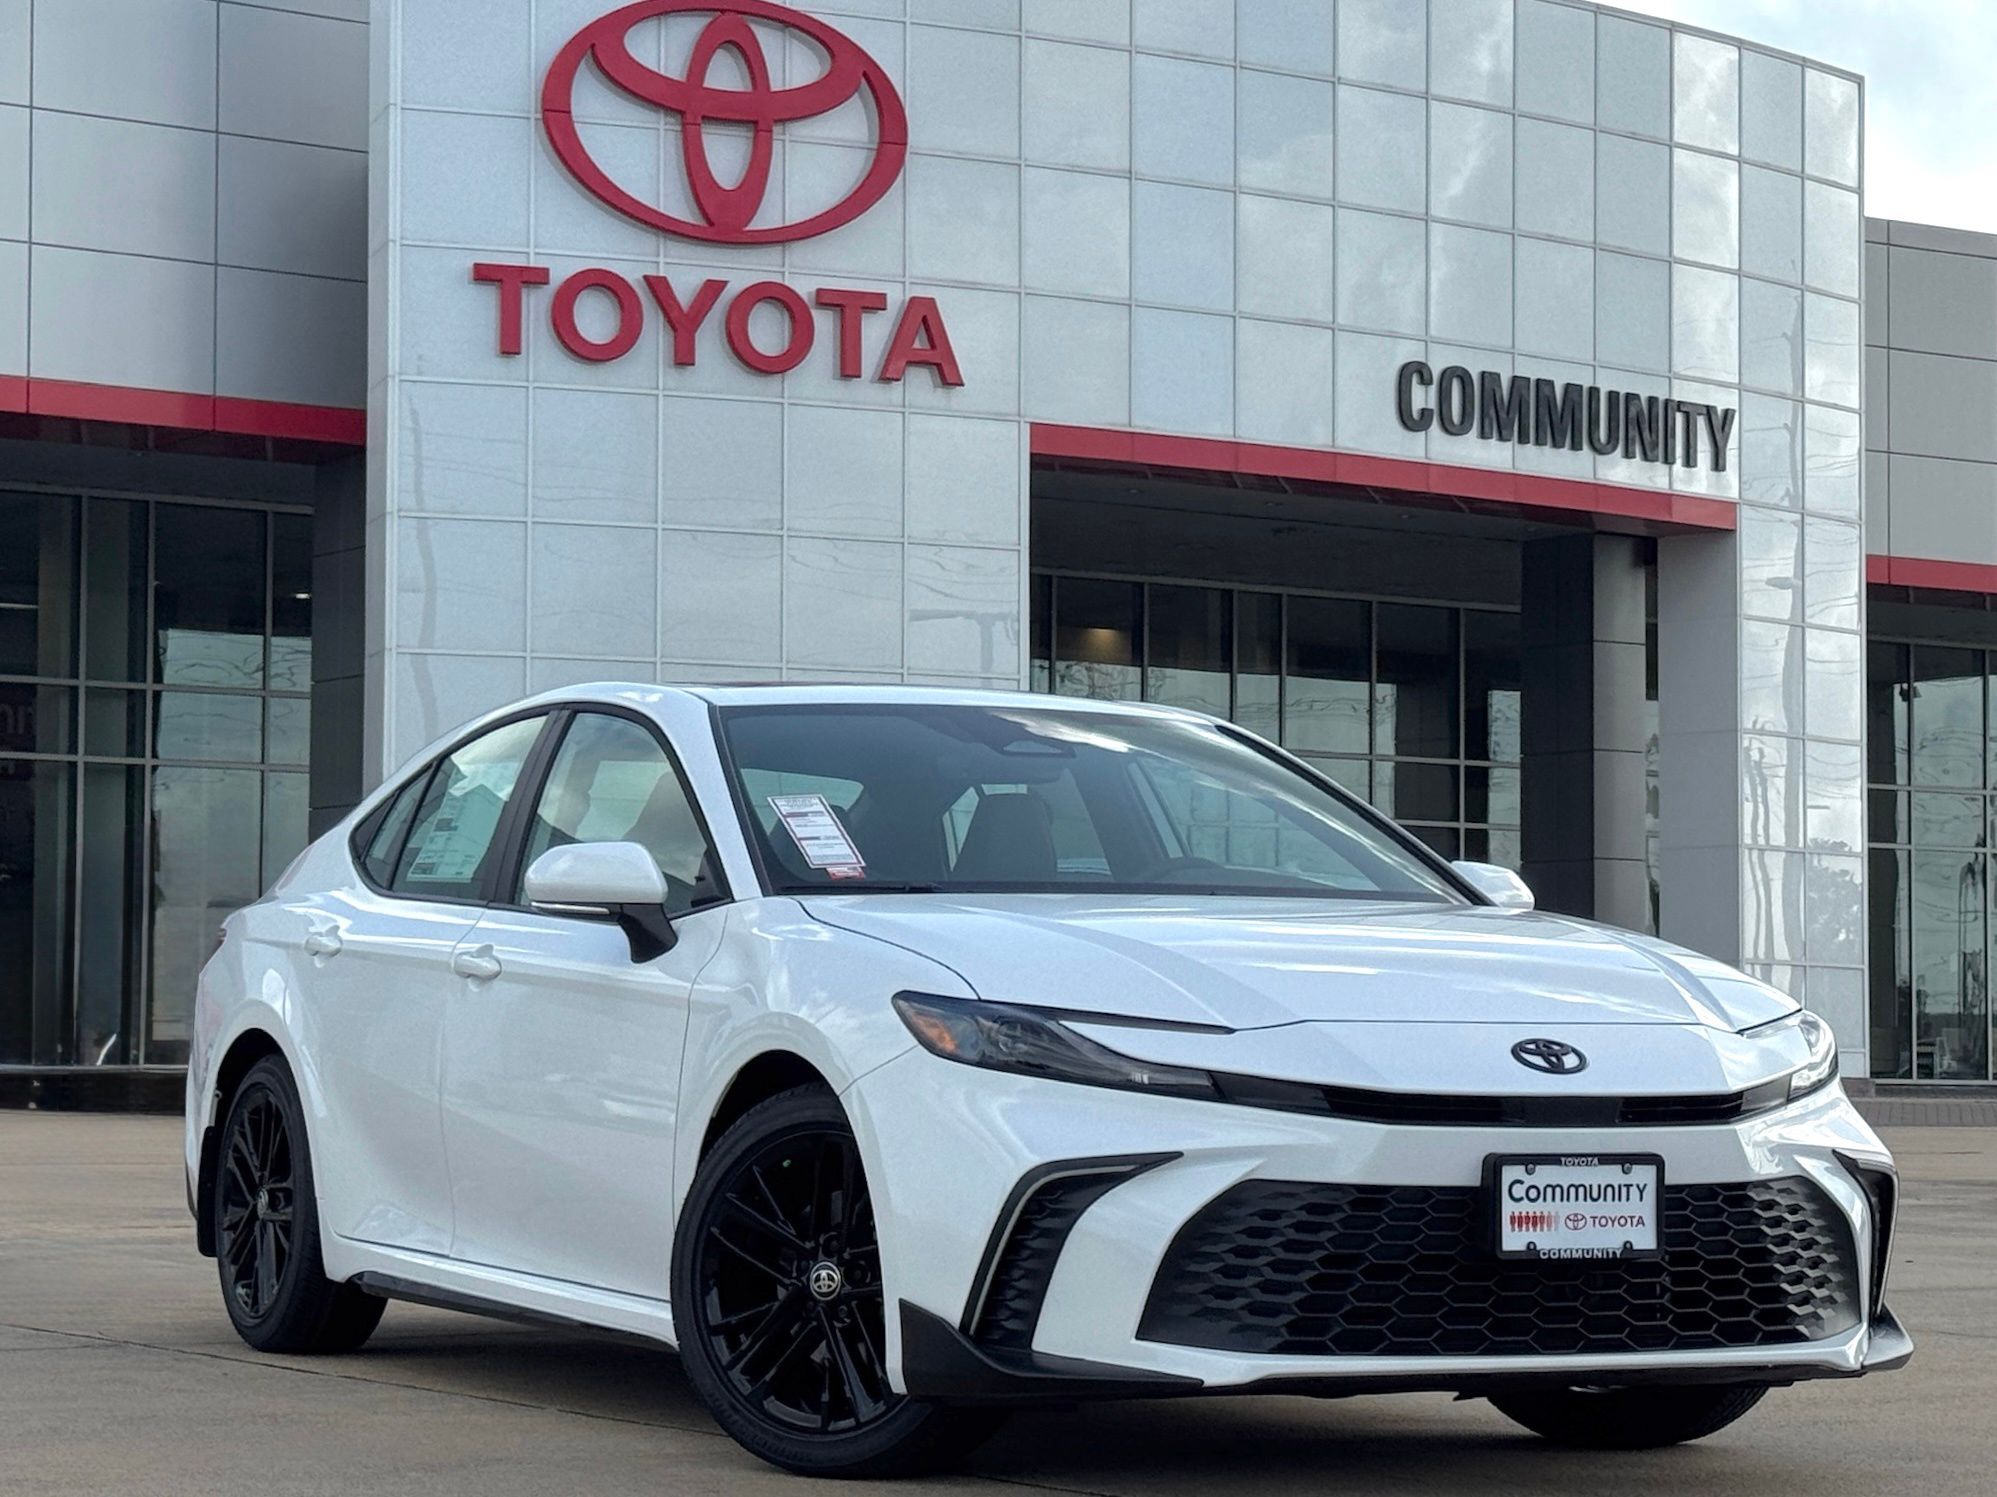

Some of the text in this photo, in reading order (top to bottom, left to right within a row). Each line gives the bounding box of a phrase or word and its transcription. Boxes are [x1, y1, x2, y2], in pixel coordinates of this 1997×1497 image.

[473, 262, 965, 387] TOYOTA
[1398, 360, 1736, 472] COMMUNITY
[1560, 1157, 1600, 1167] TOYOTA
[1590, 1215, 1646, 1228] TOYOTA
[1539, 1247, 1624, 1259] COMMUNITY
